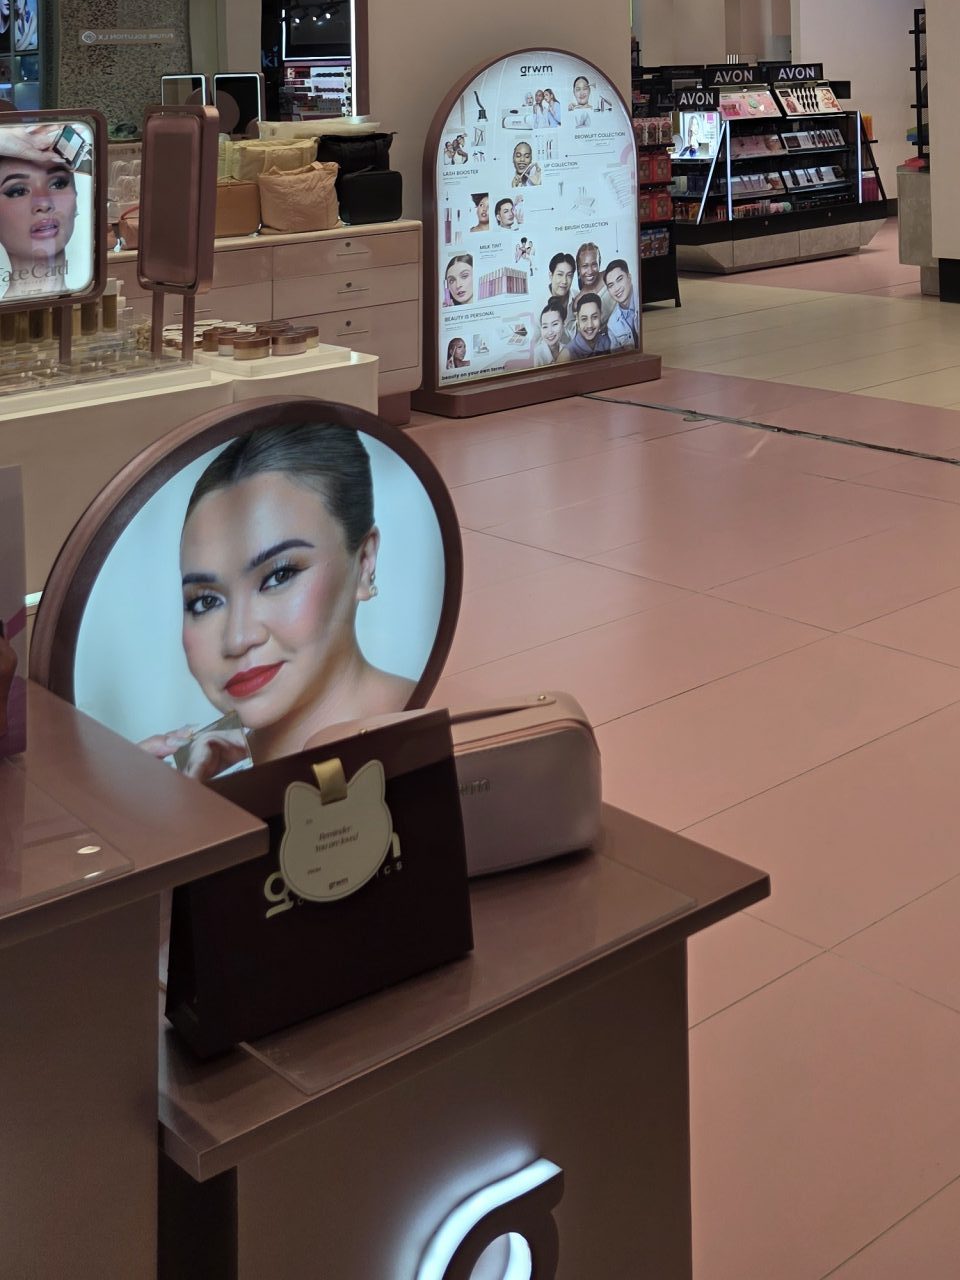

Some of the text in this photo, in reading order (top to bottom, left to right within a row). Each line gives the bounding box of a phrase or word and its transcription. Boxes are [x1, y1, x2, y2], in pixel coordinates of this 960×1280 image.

[520, 65, 553, 77] grwm
[714, 69, 753, 83] AVON
[778, 66, 815, 80] AVON
[679, 92, 714, 105] AVON
[470, 311, 495, 319] PERSONAL
[441, 373, 459, 381] beauty
